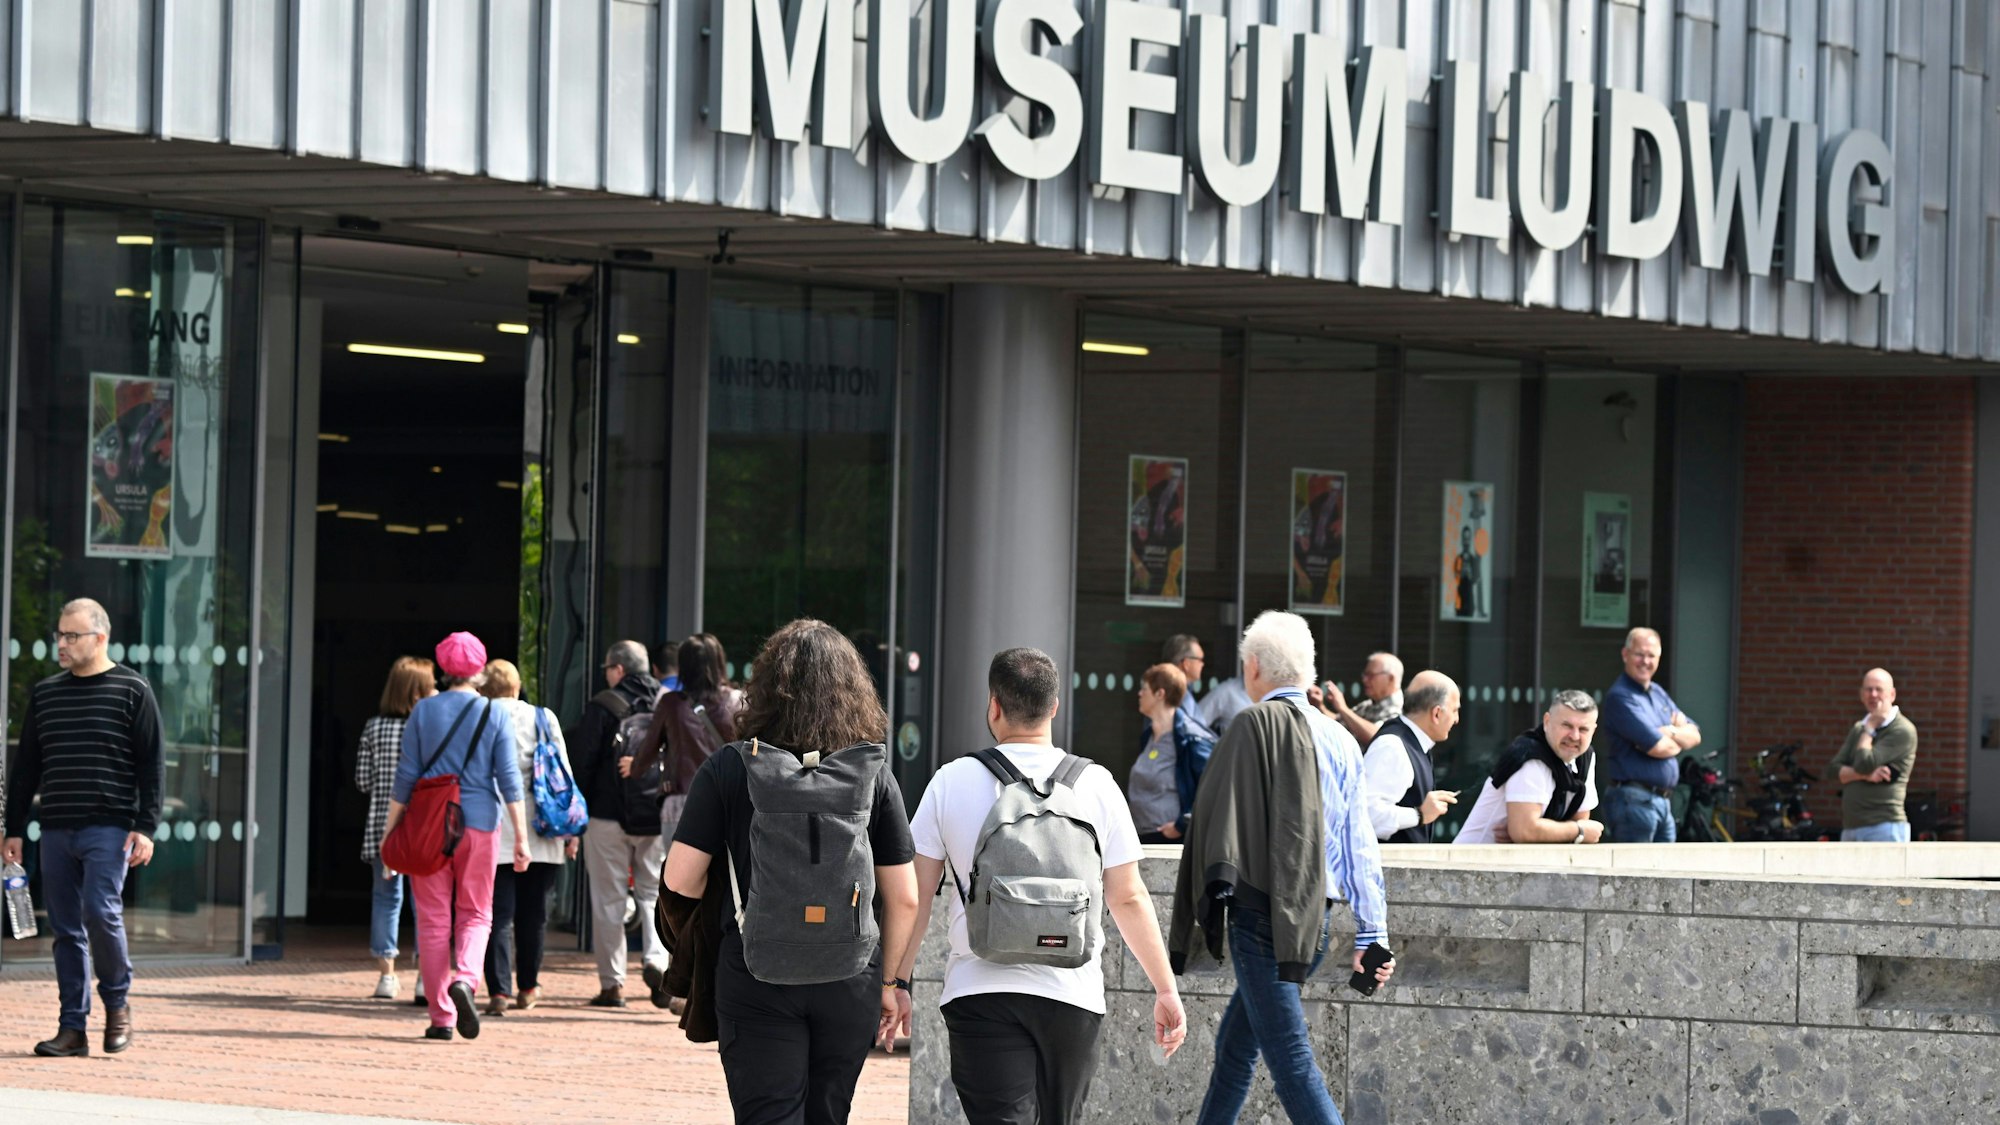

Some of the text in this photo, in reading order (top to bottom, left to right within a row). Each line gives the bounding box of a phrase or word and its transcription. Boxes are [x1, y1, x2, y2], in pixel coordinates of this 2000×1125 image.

[716, 0, 1894, 296] MUSEUM LUDWIG
[717, 355, 880, 397] INFORMATION
[115, 484, 148, 496] URSULA
